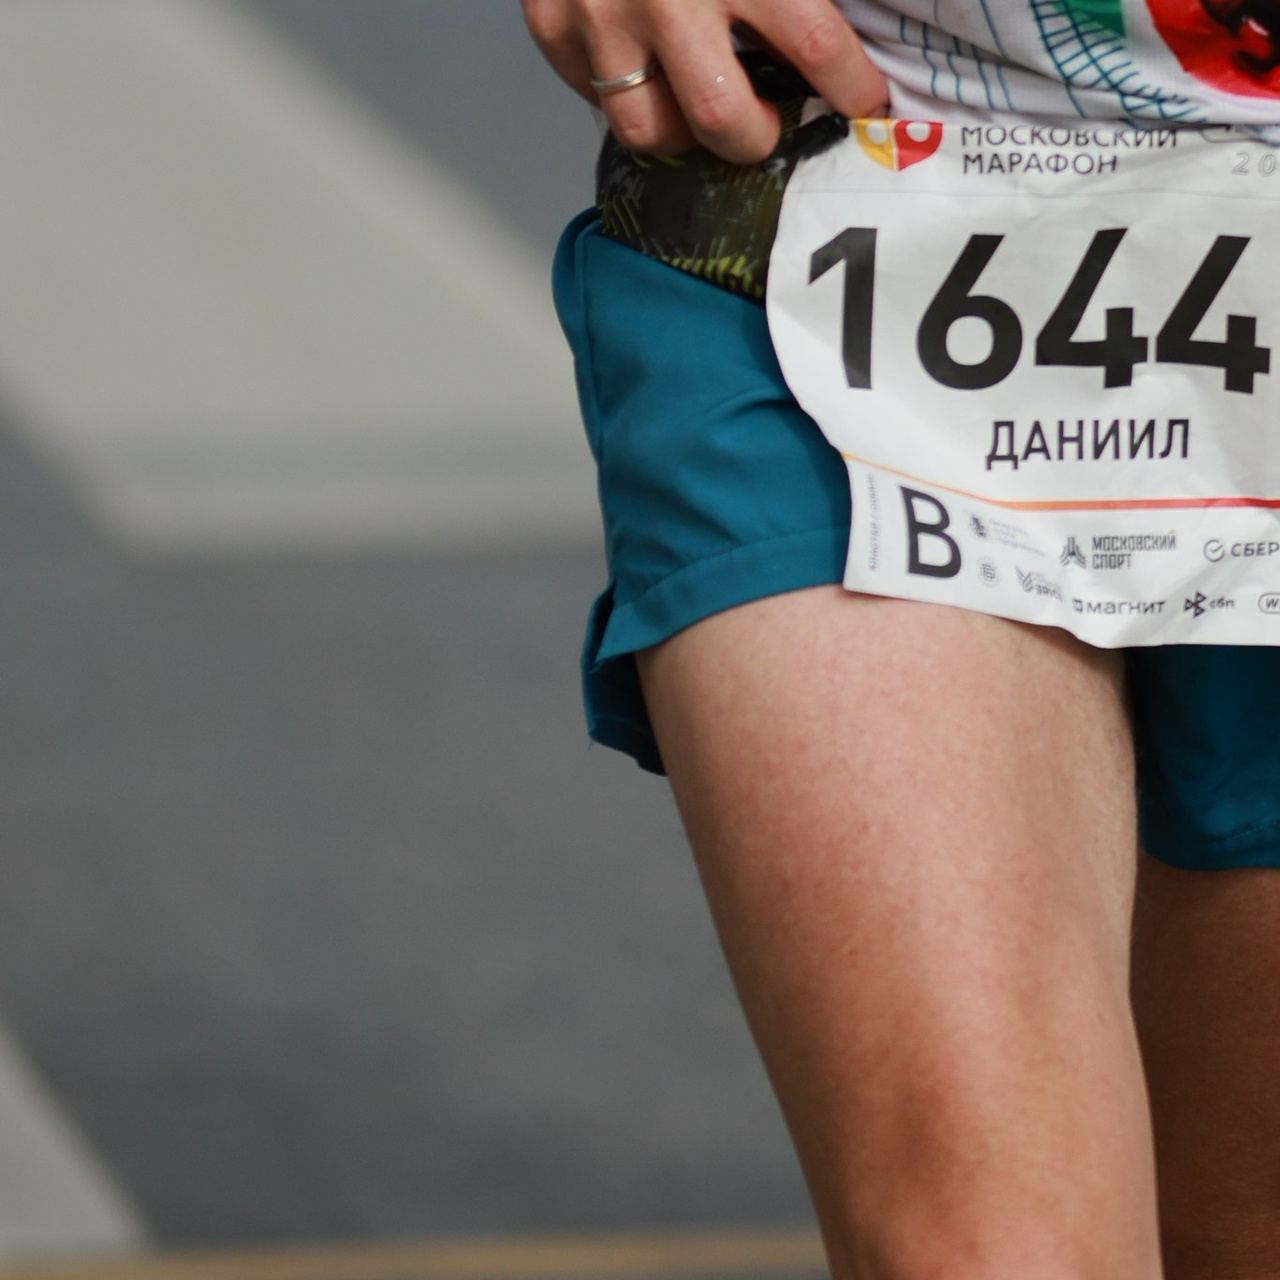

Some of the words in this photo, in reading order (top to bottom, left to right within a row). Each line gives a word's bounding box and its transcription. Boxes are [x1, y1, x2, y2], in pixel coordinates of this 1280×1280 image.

[963, 151, 1118, 175] МАРАФОН
[985, 417, 1191, 470] ДАНИИЛ
[897, 484, 962, 579] B
[1092, 531, 1177, 551] МОСКОВСКИЙ
[1230, 541, 1280, 559] СБЕР
[1092, 553, 1133, 570] СПОРТ
